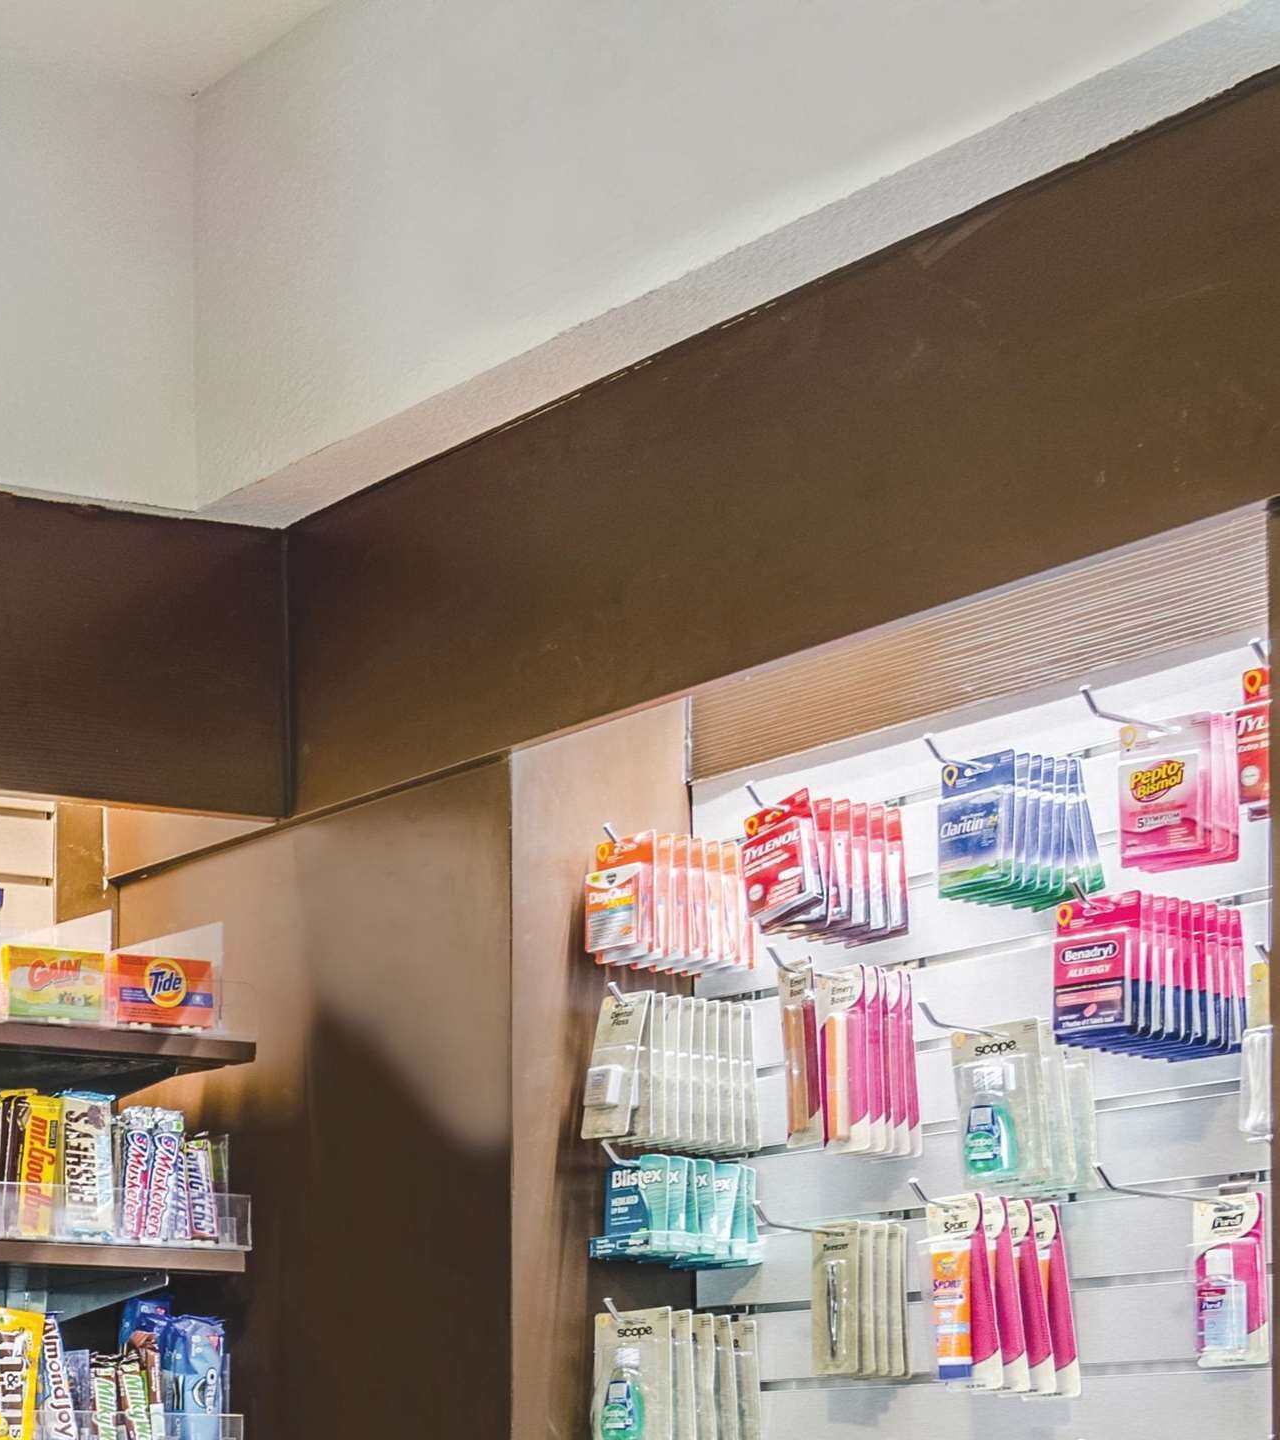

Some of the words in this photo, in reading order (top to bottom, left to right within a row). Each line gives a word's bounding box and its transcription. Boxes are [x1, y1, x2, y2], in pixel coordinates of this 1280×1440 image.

[1129, 759, 1185, 788] Pepto-
[1137, 772, 1184, 799] Bismol
[941, 815, 983, 838] Claritin
[743, 830, 802, 865] TYLENOL
[1062, 942, 1113, 963] Benadryl
[148, 967, 182, 996] Tide
[1066, 963, 1111, 979] ALLERGY
[974, 1038, 1017, 1057] scope
[124, 1148, 145, 1236] Musketeers
[148, 1150, 174, 1237] Musketeers
[617, 1325, 653, 1338] scope
[43, 1319, 69, 1400] Almond
